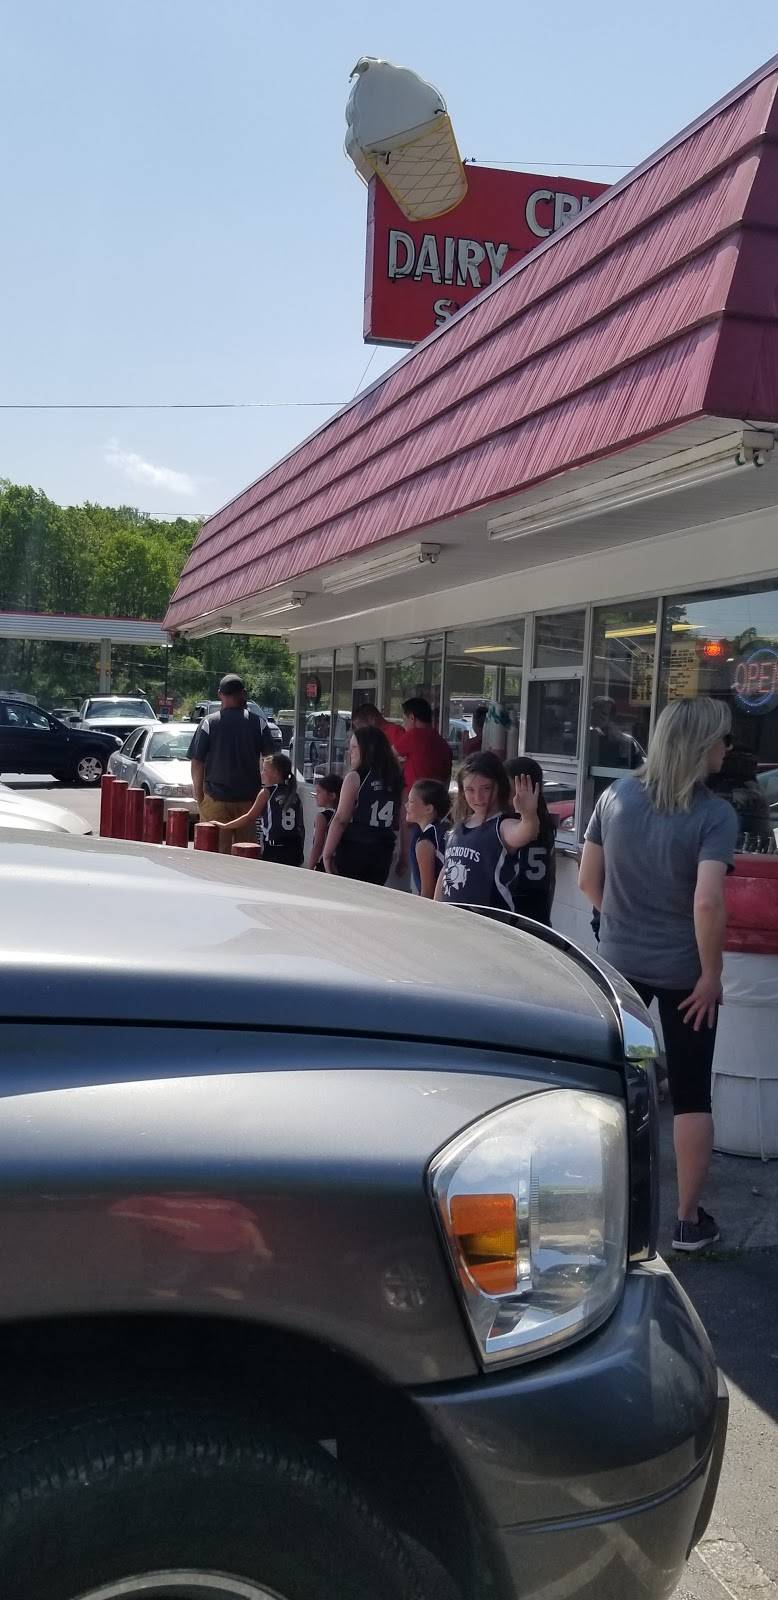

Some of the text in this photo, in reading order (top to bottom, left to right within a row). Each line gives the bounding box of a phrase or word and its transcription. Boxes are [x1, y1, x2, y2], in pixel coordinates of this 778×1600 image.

[525, 189, 593, 238] CR
[387, 229, 509, 288] DAIRY
[281, 807, 296, 831] 8
[369, 800, 394, 827] 14
[525, 847, 547, 881] 5
